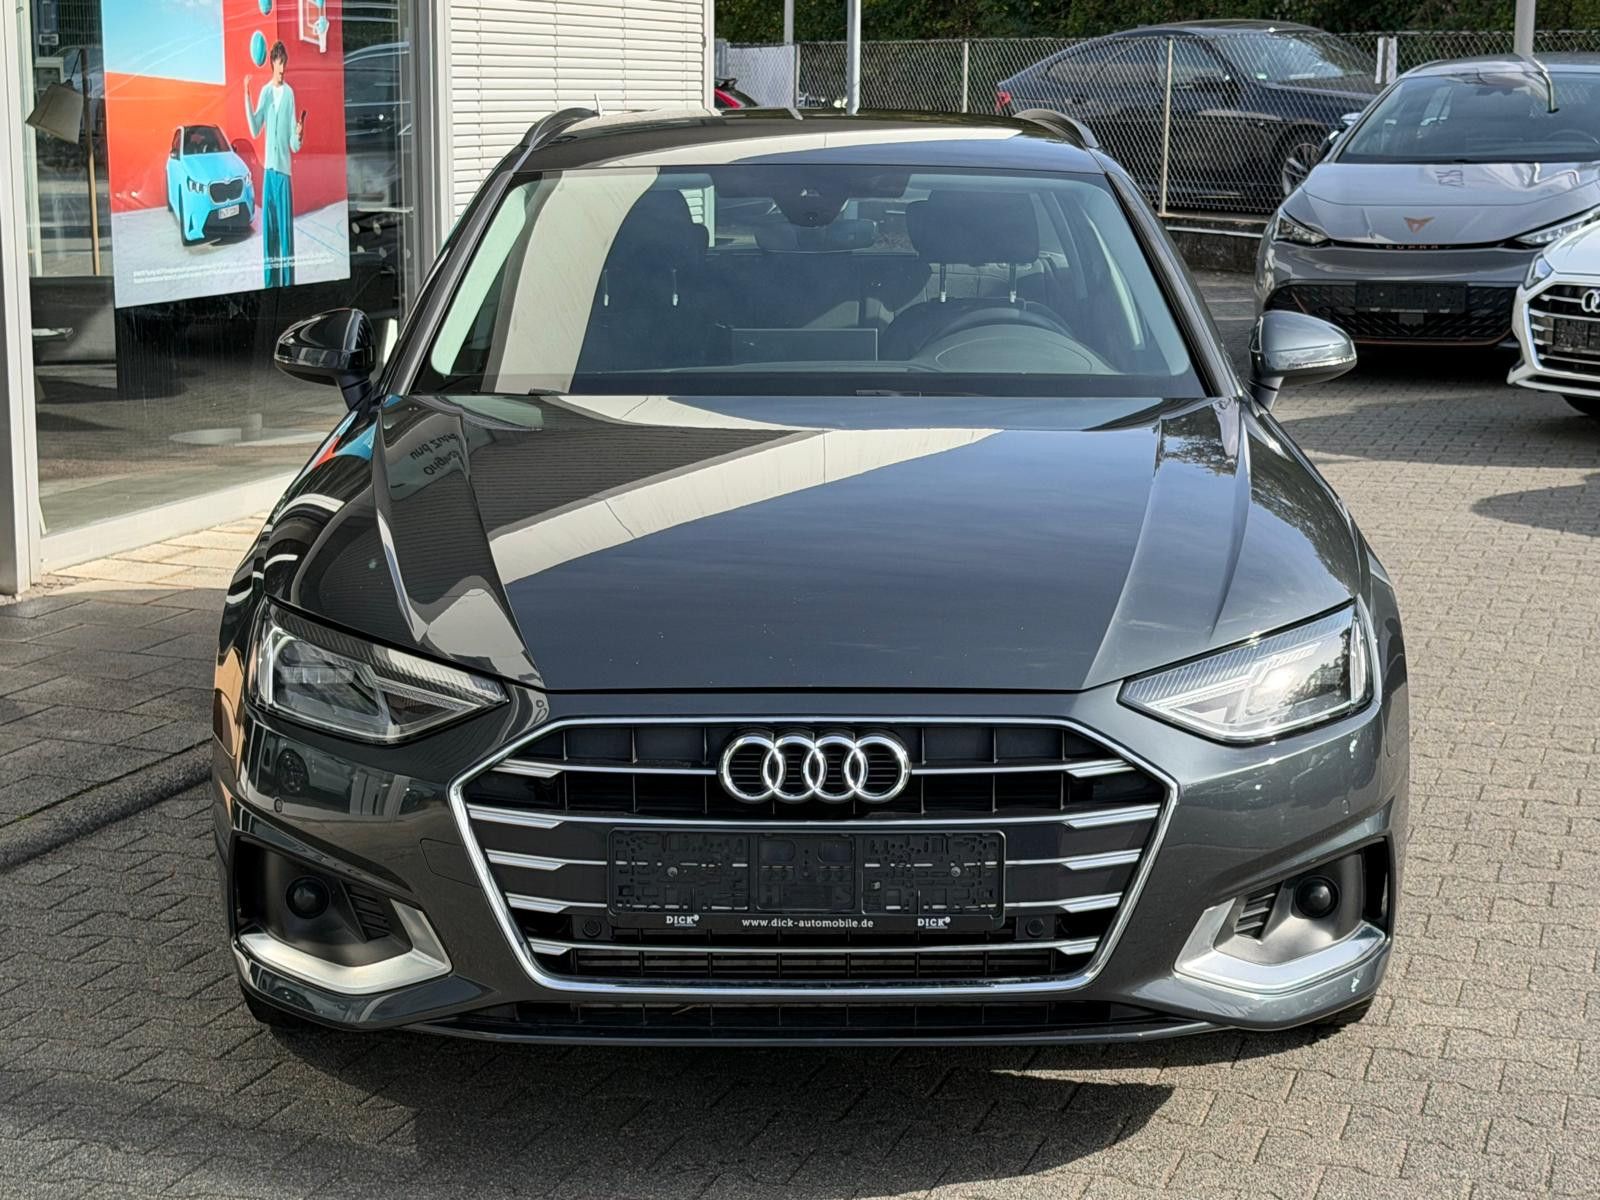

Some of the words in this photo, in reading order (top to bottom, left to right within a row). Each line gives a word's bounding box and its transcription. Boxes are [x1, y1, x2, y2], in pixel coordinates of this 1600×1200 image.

[666, 915, 696, 924] DICK
[742, 918, 874, 928] www.dick-automobile.de
[917, 917, 946, 927] DICK
